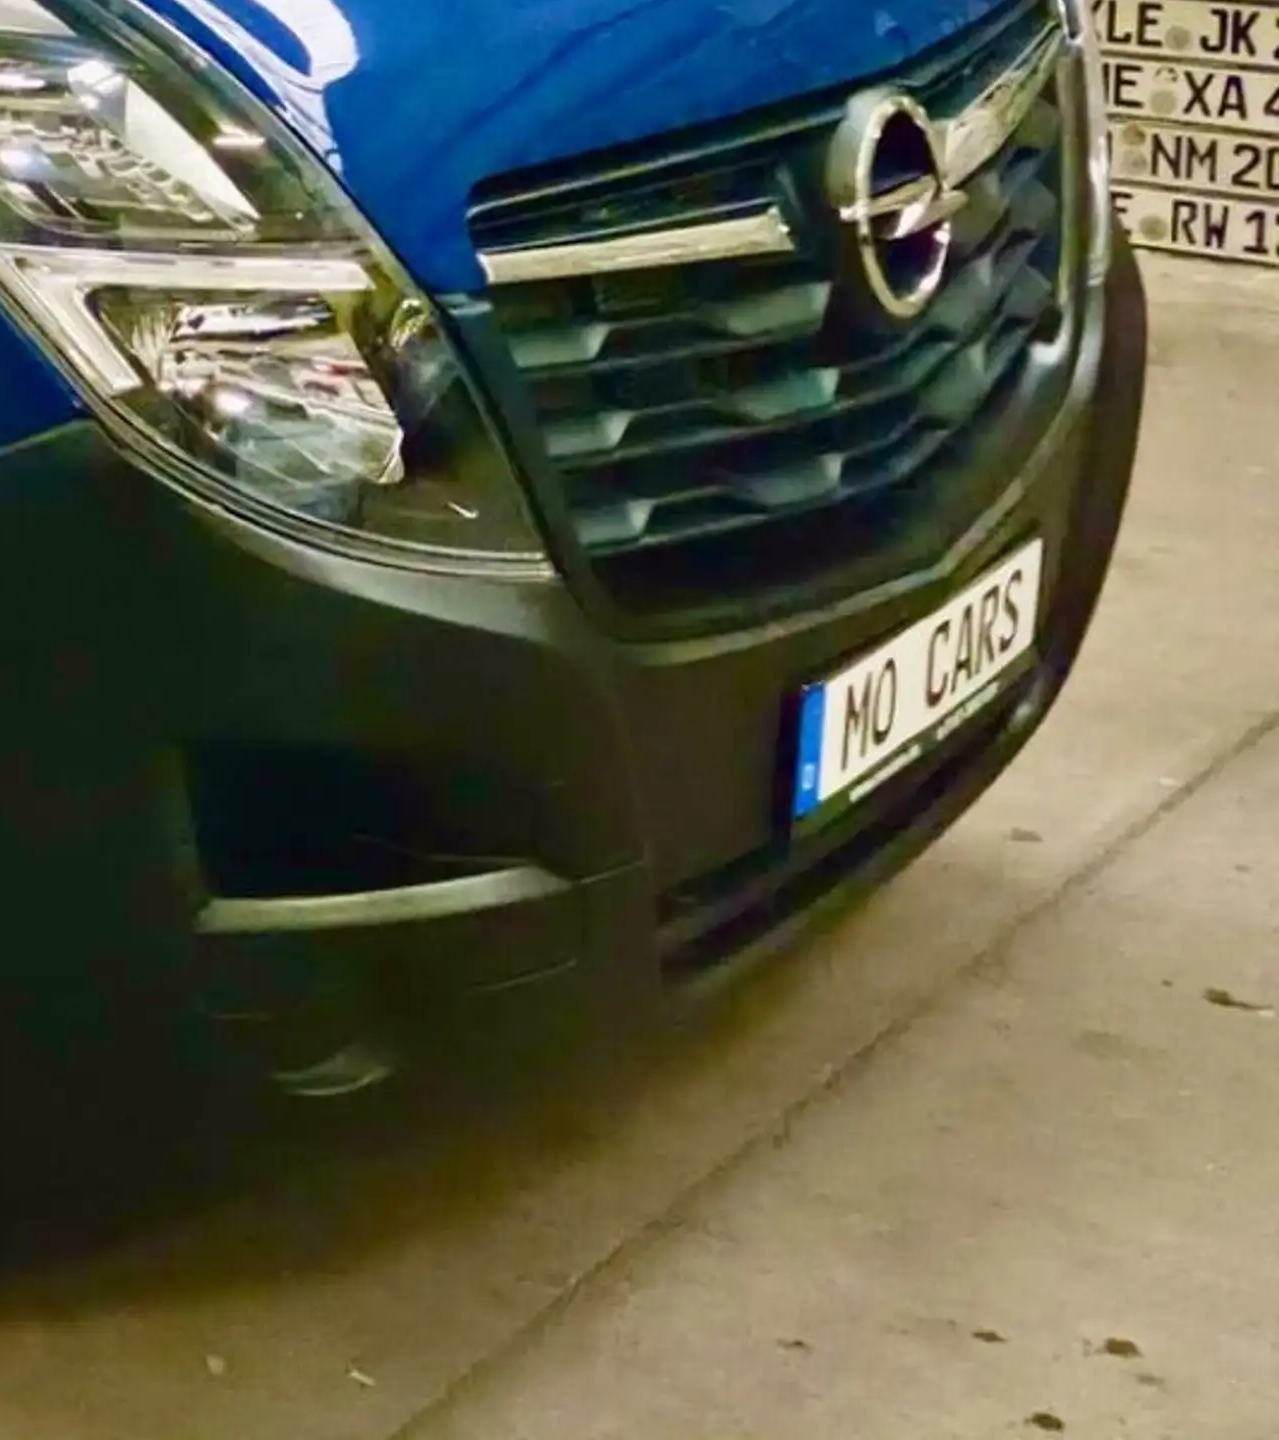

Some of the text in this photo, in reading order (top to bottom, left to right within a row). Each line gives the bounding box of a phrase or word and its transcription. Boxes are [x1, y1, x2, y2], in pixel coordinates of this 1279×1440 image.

[1200, 8, 1261, 57] JK
[1183, 70, 1247, 120] XA
[1151, 133, 1217, 183] NM
[1172, 199, 1229, 248] RW
[1242, 211, 1279, 255] 1
[842, 569, 1023, 771] MO CARS
